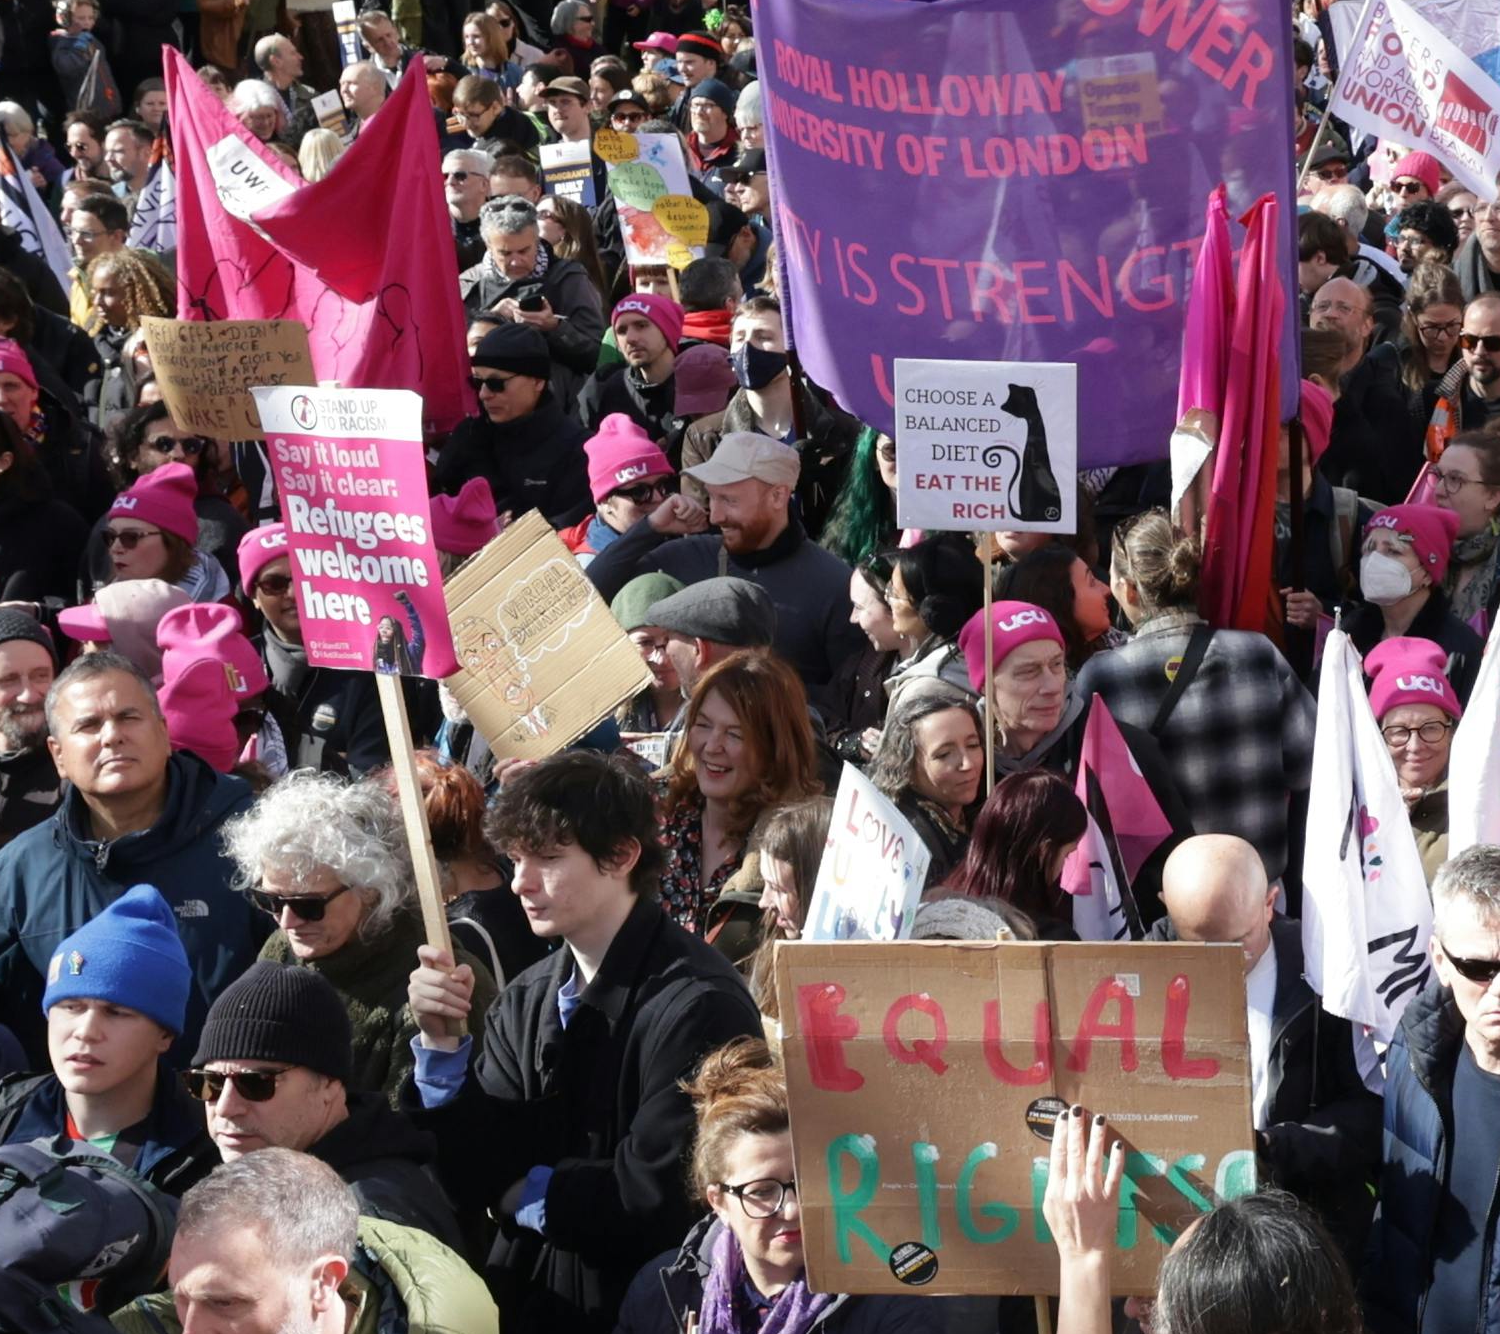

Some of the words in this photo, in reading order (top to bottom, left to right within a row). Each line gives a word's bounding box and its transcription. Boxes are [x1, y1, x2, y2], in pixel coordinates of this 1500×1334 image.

[775, 42, 843, 113] ROYAL
[848, 63, 1065, 118] HOLLOWAY
[1351, 67, 1430, 122] WORKERS
[1341, 74, 1428, 140] UNION
[899, 128, 948, 174] OF
[959, 124, 1149, 176] LONDON
[832, 224, 880, 299] IS
[889, 235, 1200, 325] STRENGT
[614, 298, 650, 316] UCU
[319, 397, 360, 416] STAND
[362, 398, 379, 415] UP
[904, 388, 978, 407] CHOOSE
[979, 390, 997, 407] A
[319, 415, 337, 432] TO
[338, 414, 388, 433] RACISM
[904, 414, 1002, 434] BALANCED
[273, 438, 313, 472] Say
[314, 441, 331, 467] it
[331, 443, 380, 469] loud
[931, 444, 980, 463] DIET
[282, 467, 320, 500] Say
[321, 470, 337, 495] it
[336, 471, 399, 499] clear:
[614, 461, 648, 483] UCU
[915, 473, 960, 491] EAT
[962, 474, 1003, 493] THE
[286, 494, 428, 551] Refugees
[952, 502, 1007, 521] RICH
[296, 542, 428, 590] welcome
[302, 581, 373, 627] here
[503, 566, 572, 621] VERBAL
[996, 608, 1050, 635] UCU
[1395, 674, 1446, 698] UCU
[796, 973, 1221, 1095] EQUAL
